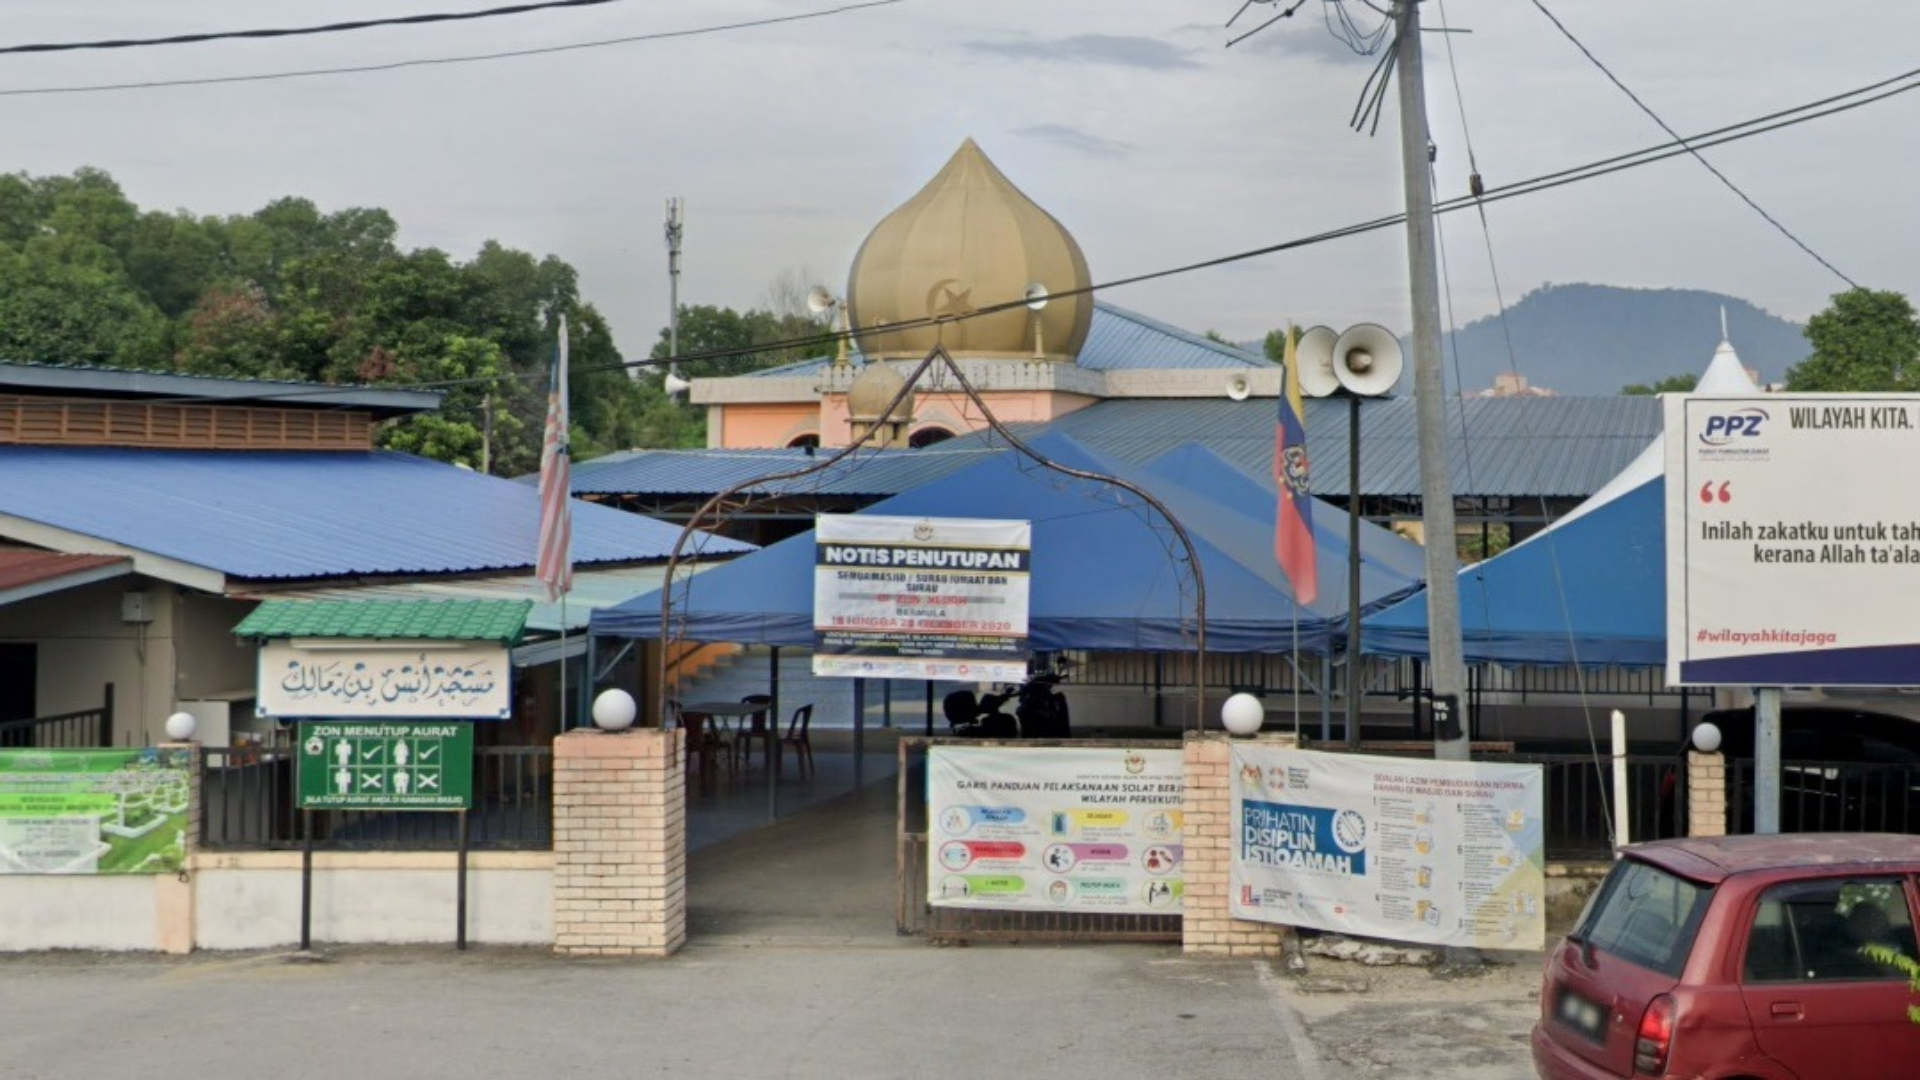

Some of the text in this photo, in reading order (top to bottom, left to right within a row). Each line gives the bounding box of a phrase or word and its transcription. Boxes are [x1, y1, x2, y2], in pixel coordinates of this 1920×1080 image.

[1706, 415, 1763, 437] PPZ
[1790, 407, 1866, 429] WILAYAH
[1871, 407, 1914, 429] KITA.
[1702, 521, 1752, 540] Inilah
[1757, 521, 1829, 540] zakatku
[1834, 521, 1887, 540] untuk
[826, 547, 1020, 569] NOTIS PENUTUPAN
[1754, 544, 1920, 563] kerana Allah ta'ala
[871, 572, 906, 582] MASJID
[916, 574, 947, 583] SURAU
[950, 575, 985, 584] JUMAAT
[987, 576, 1008, 585] DAN
[906, 583, 938, 593] SURAU
[896, 608, 946, 617] BERMULA
[846, 616, 897, 627] HINGGA
[981, 620, 1011, 630] 2020
[1697, 629, 1837, 647] #wilayahkitajaga
[313, 726, 459, 737] ZON MENUTUP AURAT
[957, 780, 988, 791] GARIS
[991, 781, 1041, 791] PANDUAN
[1043, 782, 1119, 793] PELAKSANAAN
[1122, 784, 1156, 793] SOLAT
[1373, 773, 1525, 790] SOALAN LAZIM PEMBUDAYAAN NORMA
[1373, 783, 1496, 798] BAHARU DI MASJID DAN SURAU
[1081, 795, 1127, 804] WILAYAH
[1244, 807, 1316, 833] PRIHATIN
[1245, 827, 1316, 851] DISIPLIN
